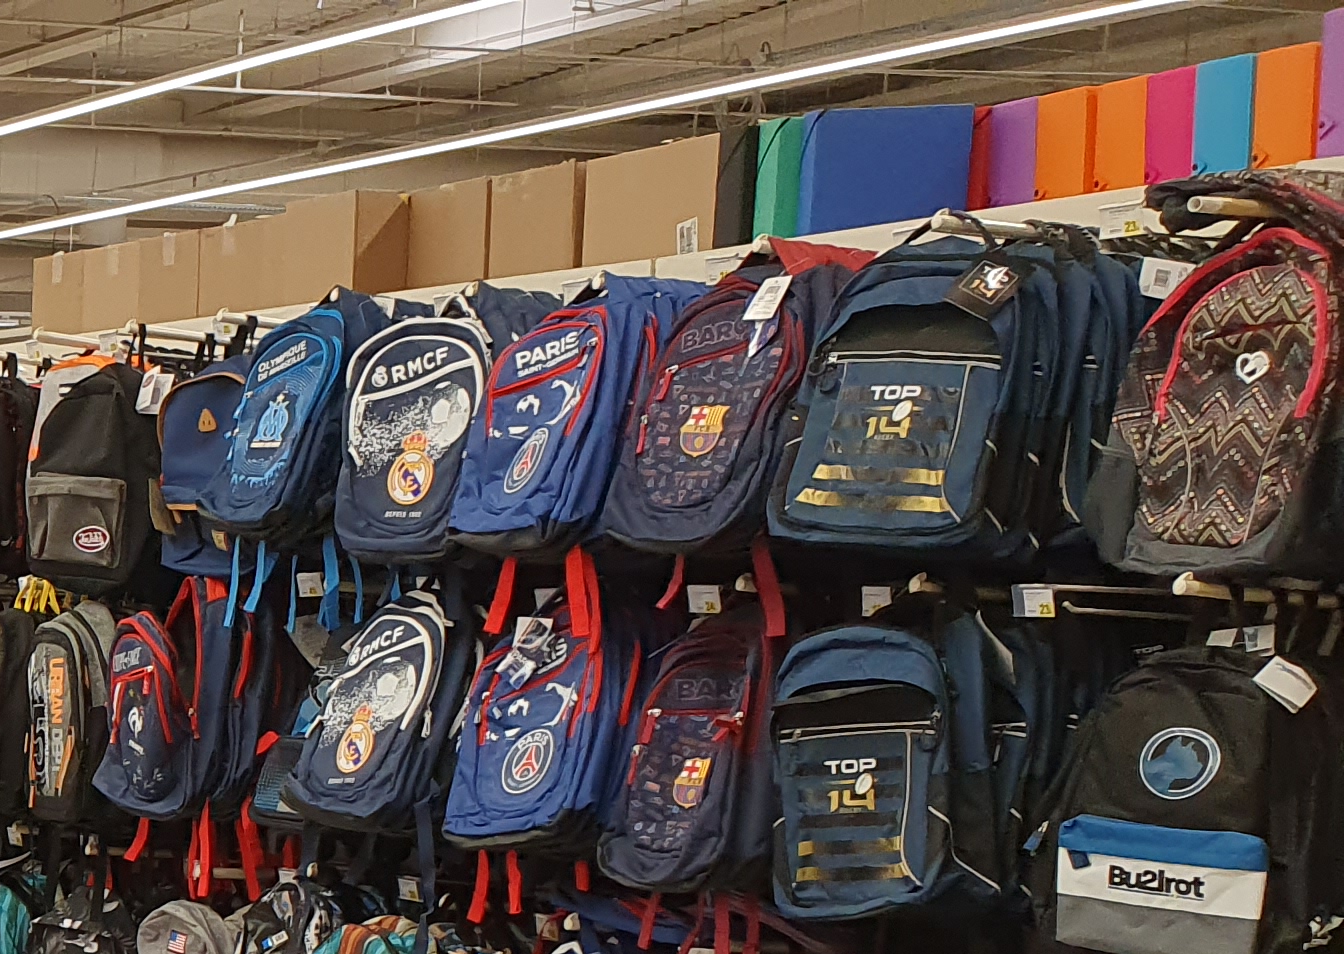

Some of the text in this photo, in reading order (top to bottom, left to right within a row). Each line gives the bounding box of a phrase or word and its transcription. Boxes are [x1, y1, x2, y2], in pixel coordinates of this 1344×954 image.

[390, 346, 450, 384] RMCF
[515, 331, 581, 369] PARIS
[870, 385, 922, 401] TOP
[865, 416, 912, 439] 14
[361, 625, 405, 661] RMCF
[49, 657, 65, 725] URBAN
[823, 757, 878, 775] TOP
[827, 788, 877, 813] 14
